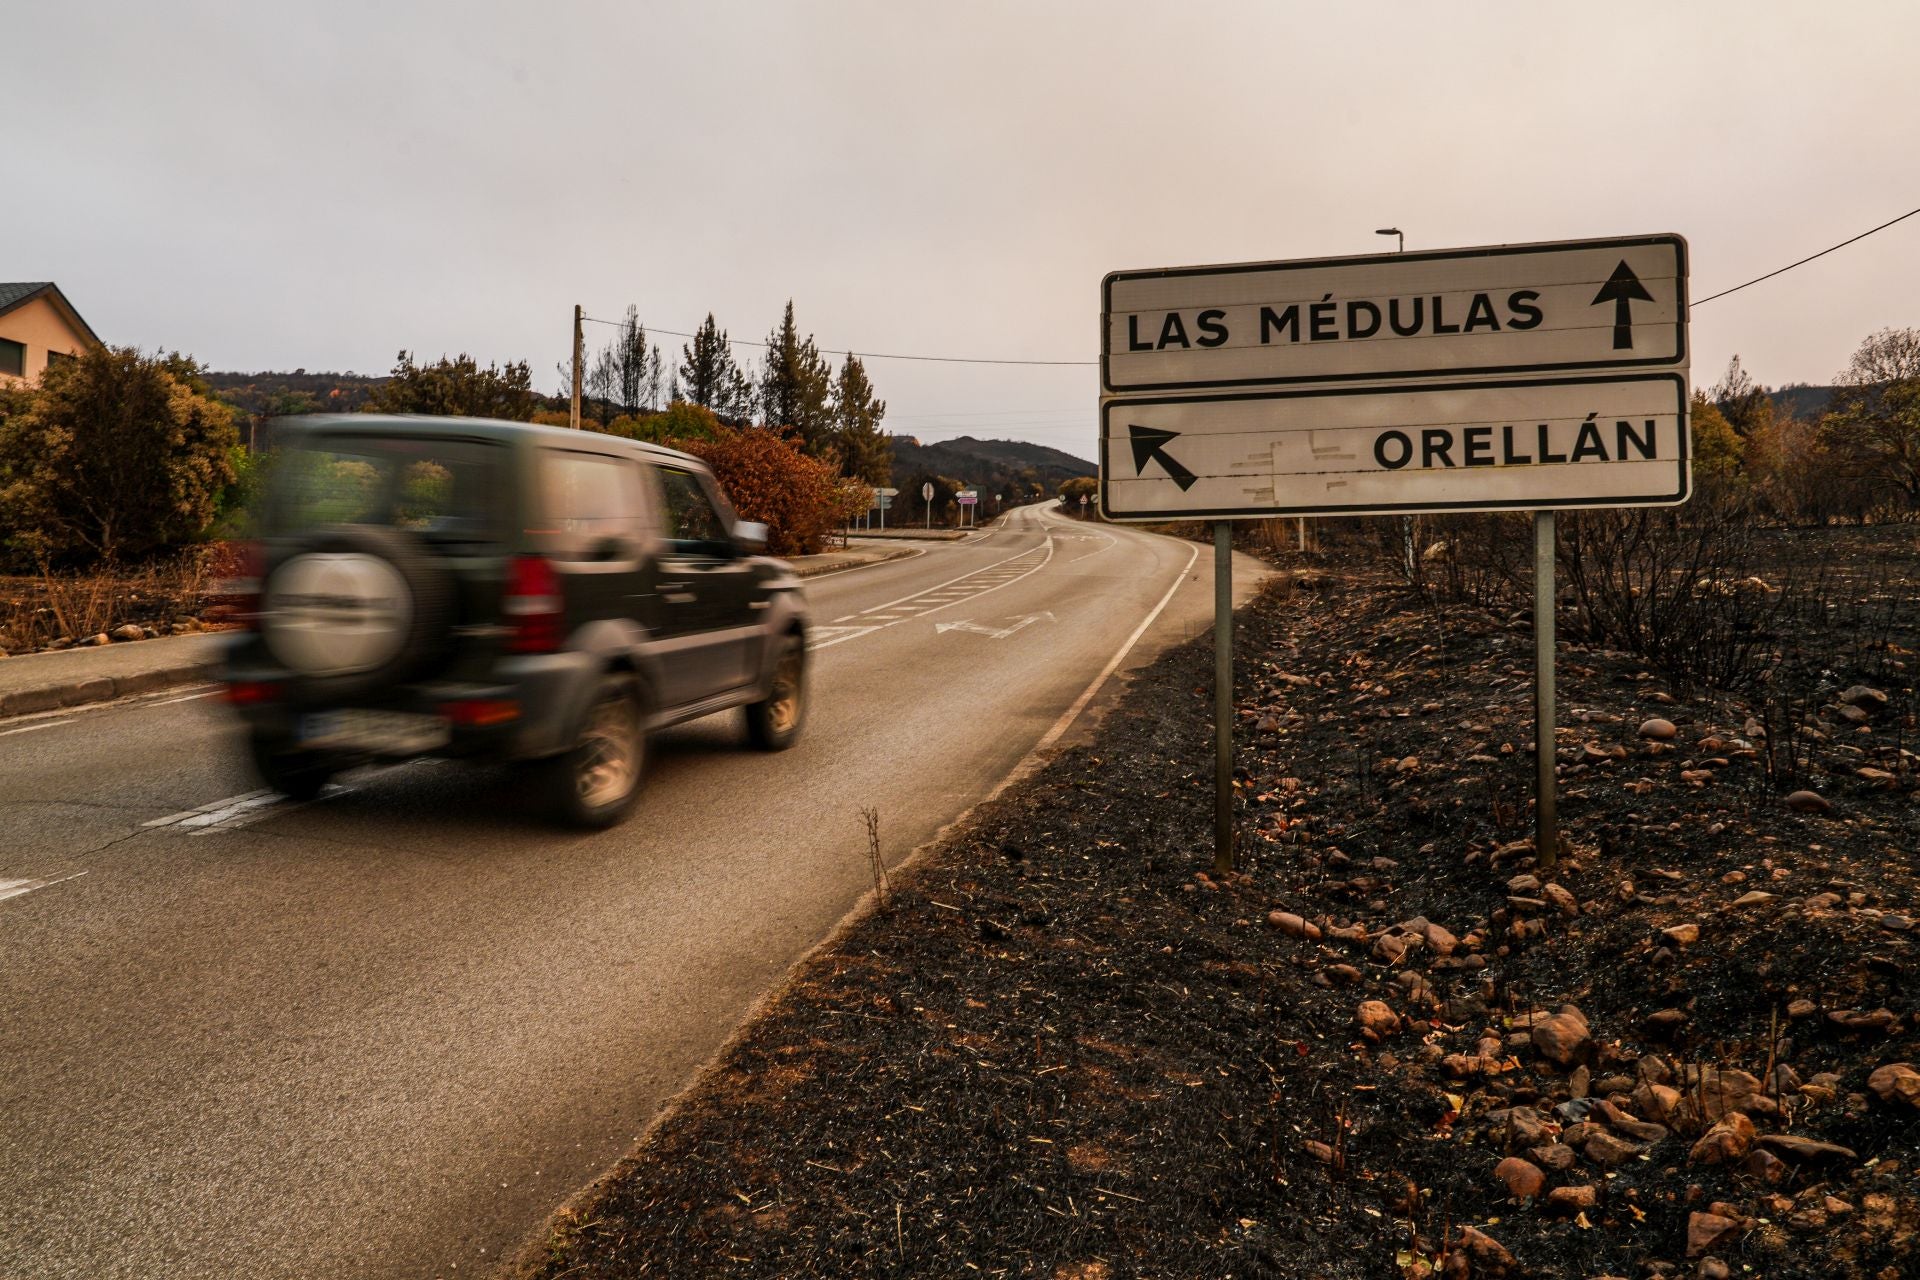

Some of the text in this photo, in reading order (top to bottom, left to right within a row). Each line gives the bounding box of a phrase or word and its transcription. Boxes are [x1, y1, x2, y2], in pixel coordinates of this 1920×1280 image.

[1128, 289, 1544, 352] LAS MÉDULAS
[1373, 412, 1657, 471] ORELLÁN
